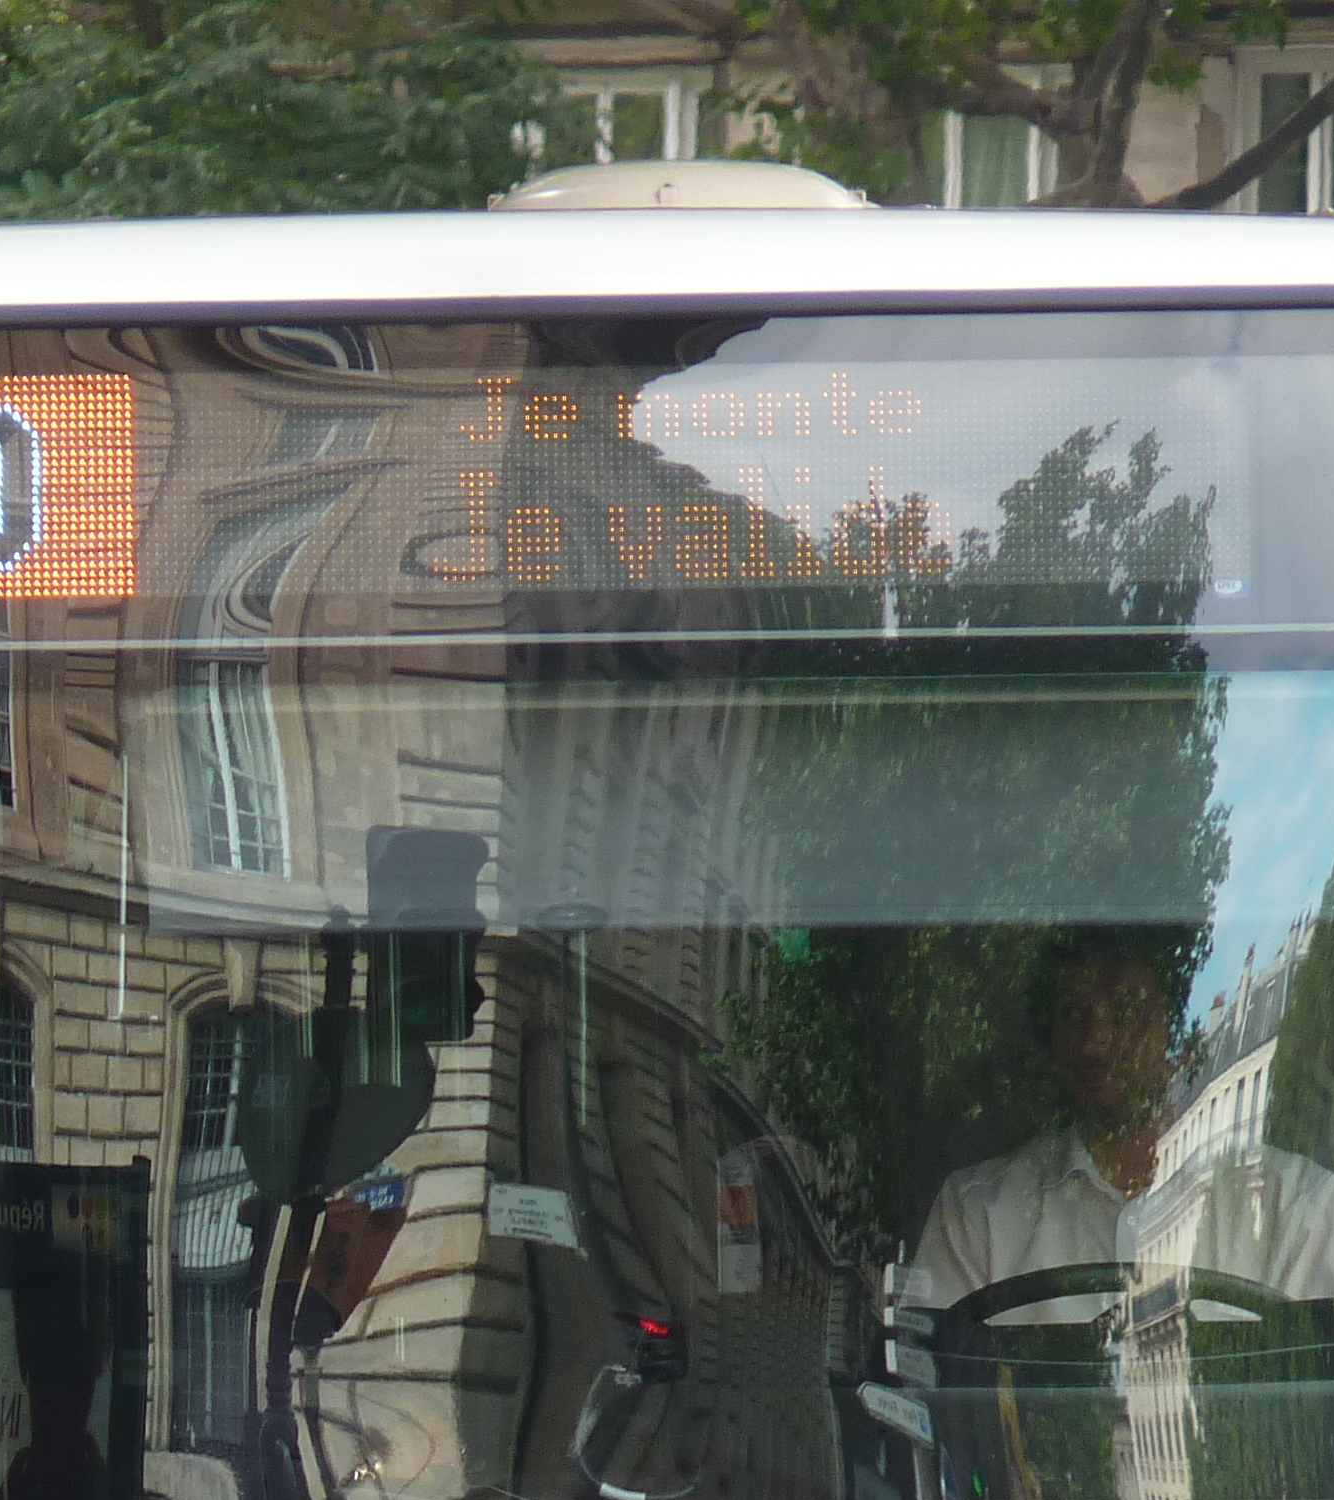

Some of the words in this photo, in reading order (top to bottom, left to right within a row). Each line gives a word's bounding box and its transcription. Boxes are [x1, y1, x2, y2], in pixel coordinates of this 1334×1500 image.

[459, 376, 579, 441] Je
[617, 372, 923, 438] monte
[432, 470, 563, 583] Je
[608, 464, 952, 577] valide
